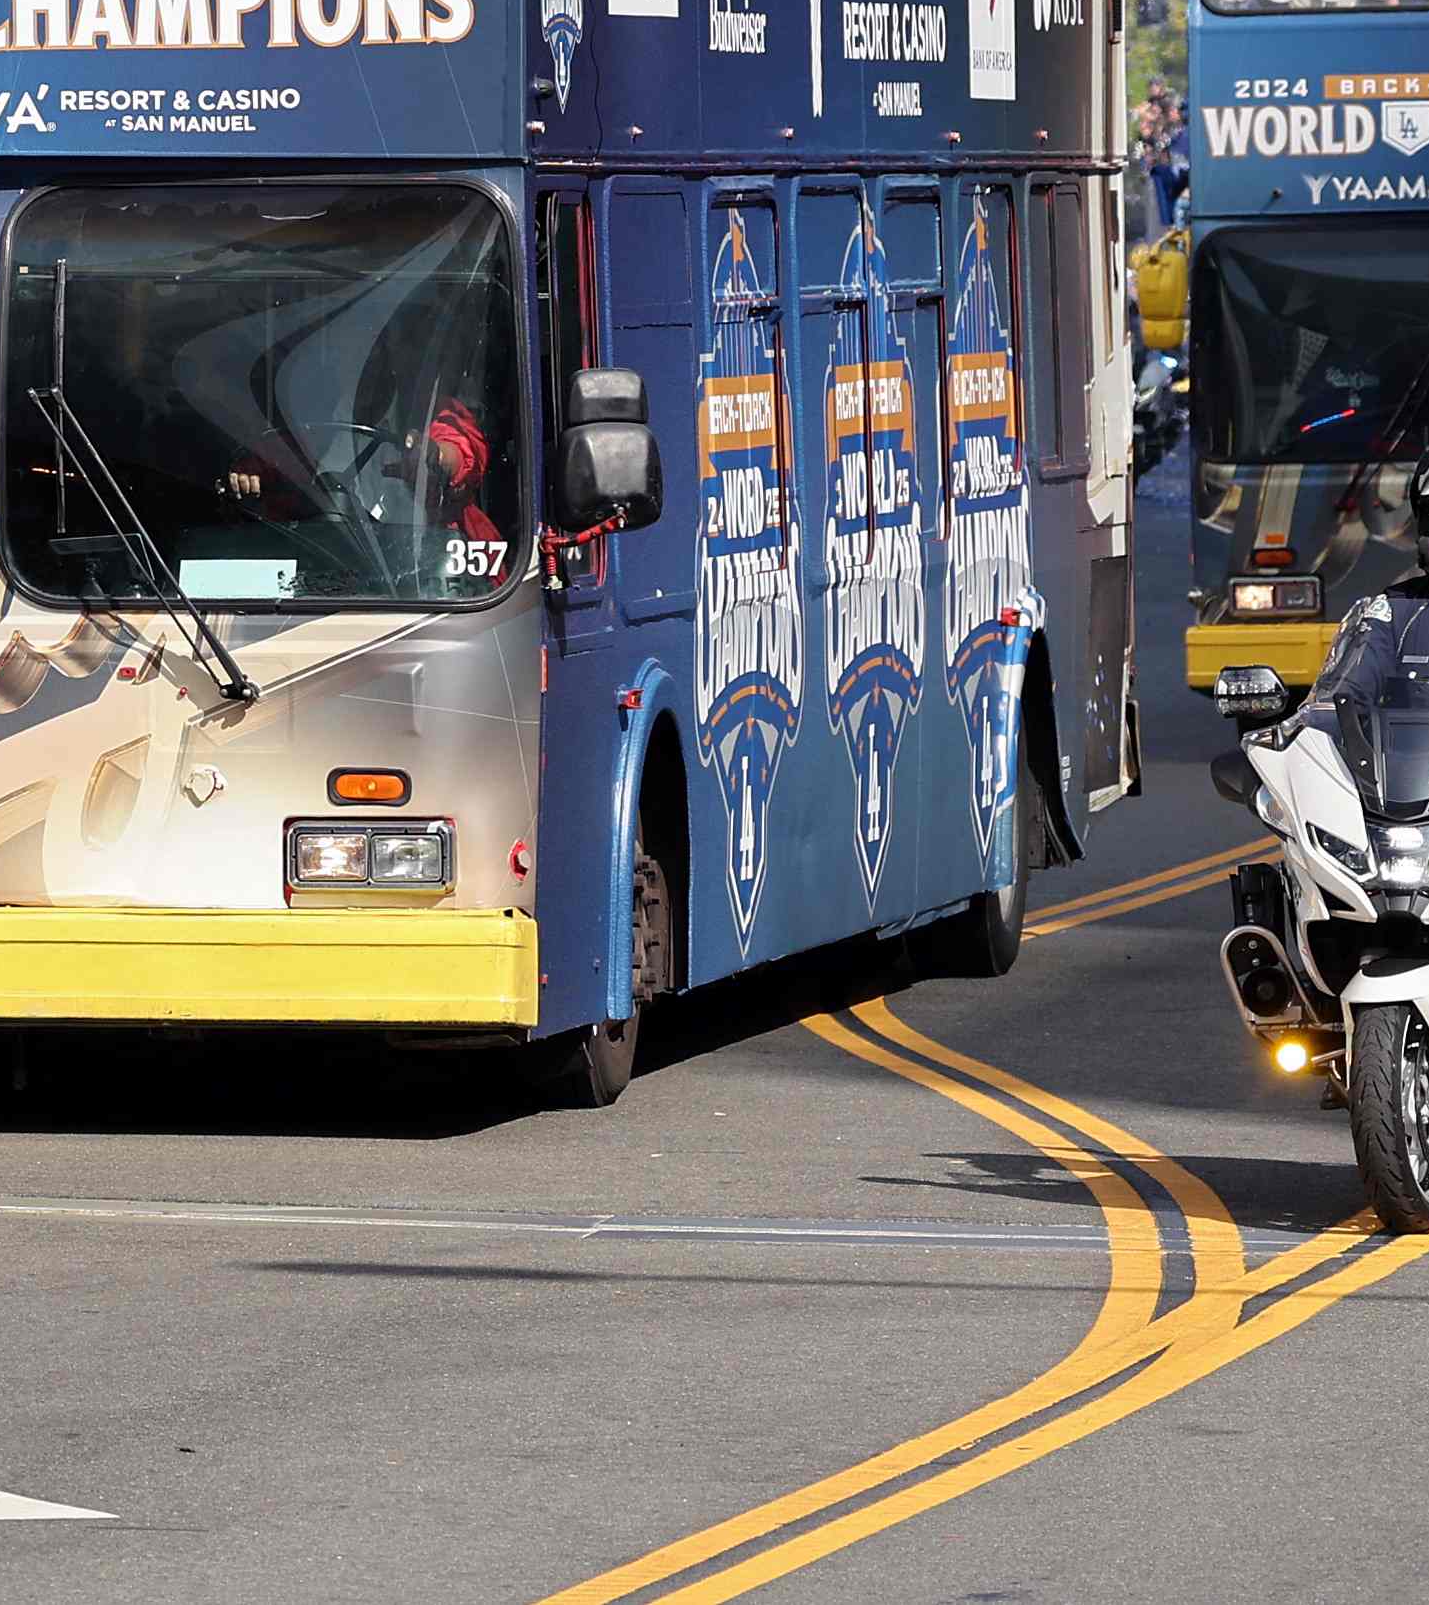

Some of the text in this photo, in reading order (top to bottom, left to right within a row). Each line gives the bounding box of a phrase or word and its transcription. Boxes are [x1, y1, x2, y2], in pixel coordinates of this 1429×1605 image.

[843, 1, 946, 62] RESORT & CASINO
[972, 49, 1013, 73] BANK OF AMERICA
[60, 89, 166, 111] RESORT
[175, 91, 190, 110] &
[198, 88, 301, 110] CASINO
[878, 81, 894, 116] SAN
[894, 82, 922, 116] MANUEL
[1234, 78, 1309, 98] 2024
[122, 115, 163, 132] SAN
[171, 115, 255, 132] MANUEL
[1201, 104, 1376, 158] WORLD
[896, 468, 909, 504] 25
[445, 540, 508, 576] 357
